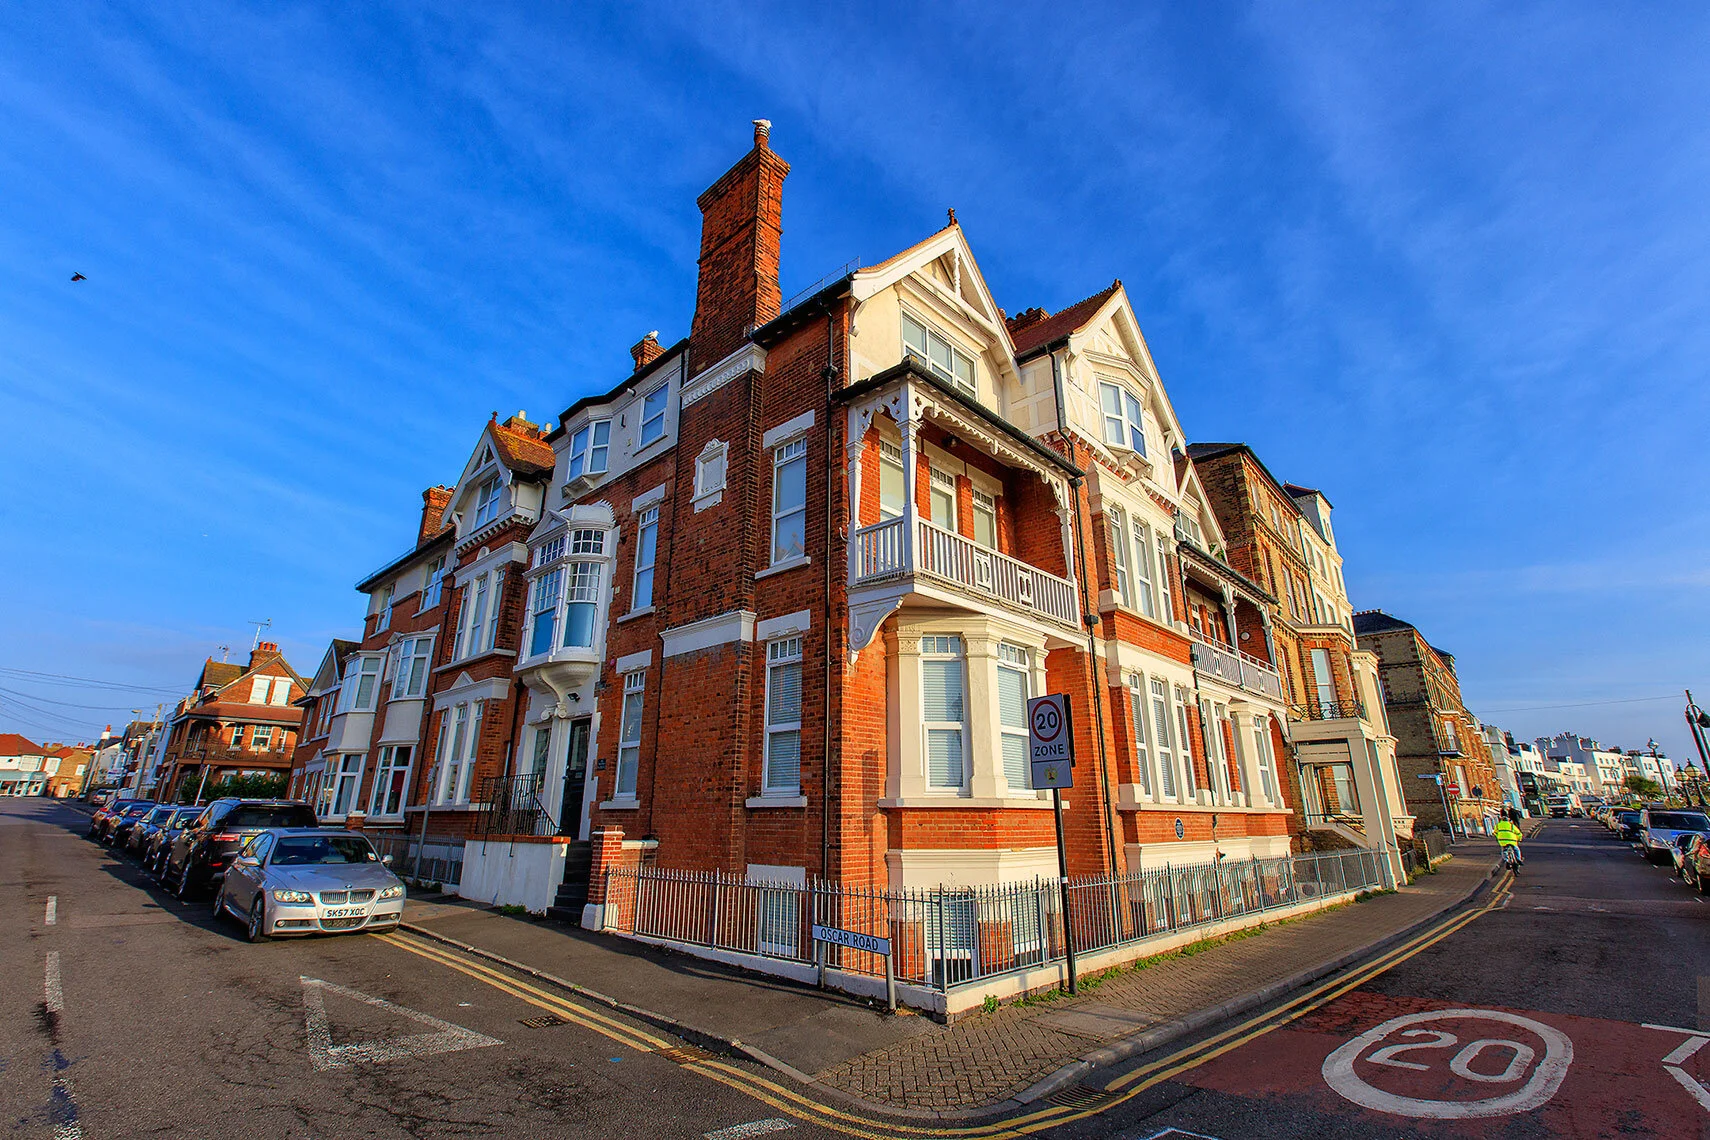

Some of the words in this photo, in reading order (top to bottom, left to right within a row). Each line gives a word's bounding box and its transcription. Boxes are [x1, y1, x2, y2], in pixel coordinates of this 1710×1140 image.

[1036, 711, 1058, 730] 20
[1034, 744, 1064, 757] ZONE
[327, 909, 348, 917] SK57
[350, 907, 365, 916] XOC
[820, 928, 850, 944] OSCAR
[853, 934, 879, 951] ROAD
[1365, 1029, 1535, 1083] 20
